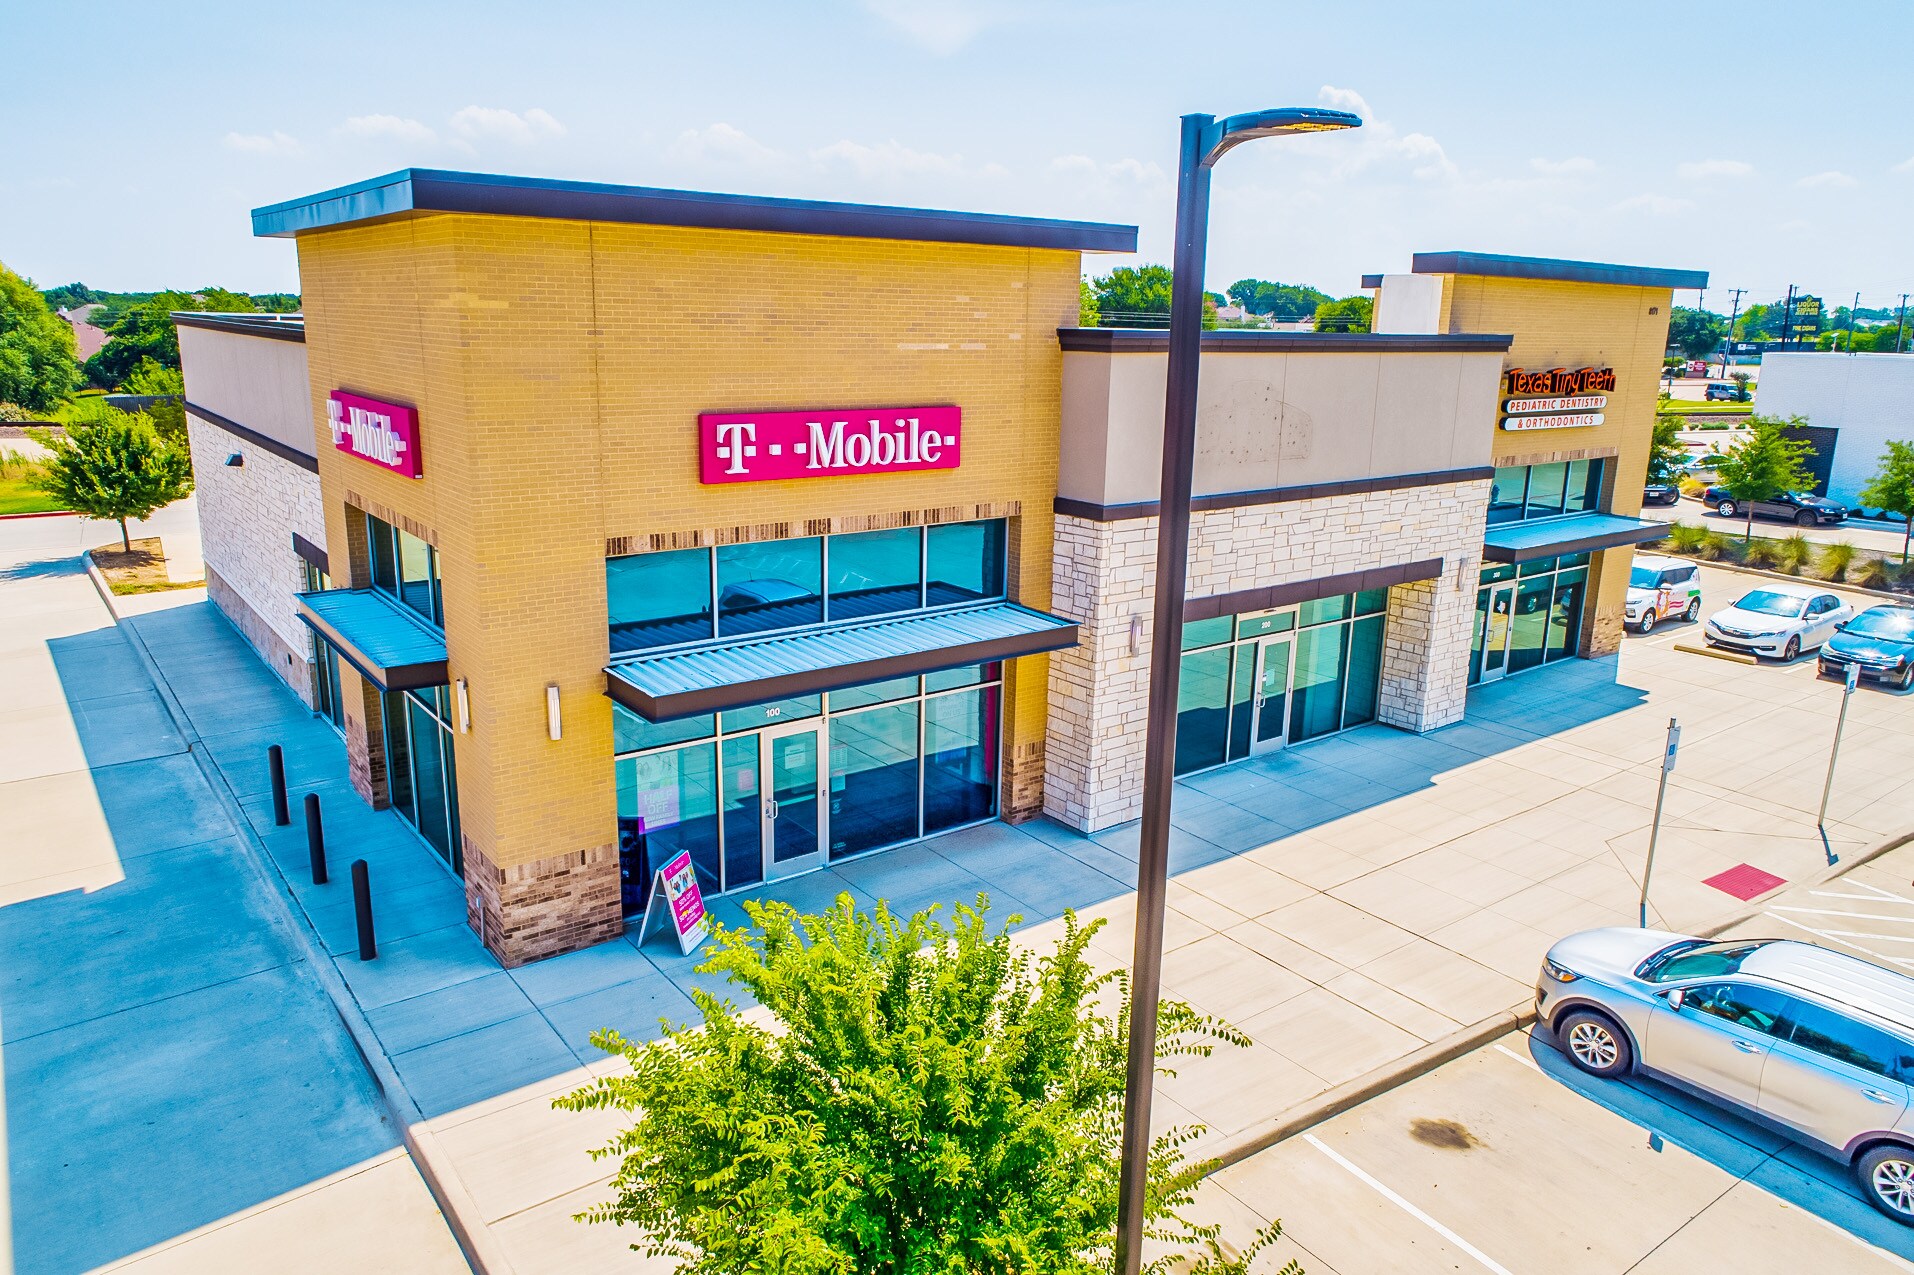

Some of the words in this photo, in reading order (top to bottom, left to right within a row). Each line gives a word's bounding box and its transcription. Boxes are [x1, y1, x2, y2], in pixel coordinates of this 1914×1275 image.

[1508, 368, 1552, 395] Texas
[1550, 367, 1581, 396] Tiny
[1579, 367, 1617, 393] Teeth
[1510, 400, 1556, 411] PEDIATRIC
[1559, 397, 1605, 409] DENTISTRY
[1517, 418, 1524, 429] &
[1525, 415, 1595, 428] ORTHODONTICS
[1261, 620, 1271, 629] 200
[765, 707, 781, 718] 100
[644, 790, 673, 805] HALF
[647, 802, 669, 815] OFF
